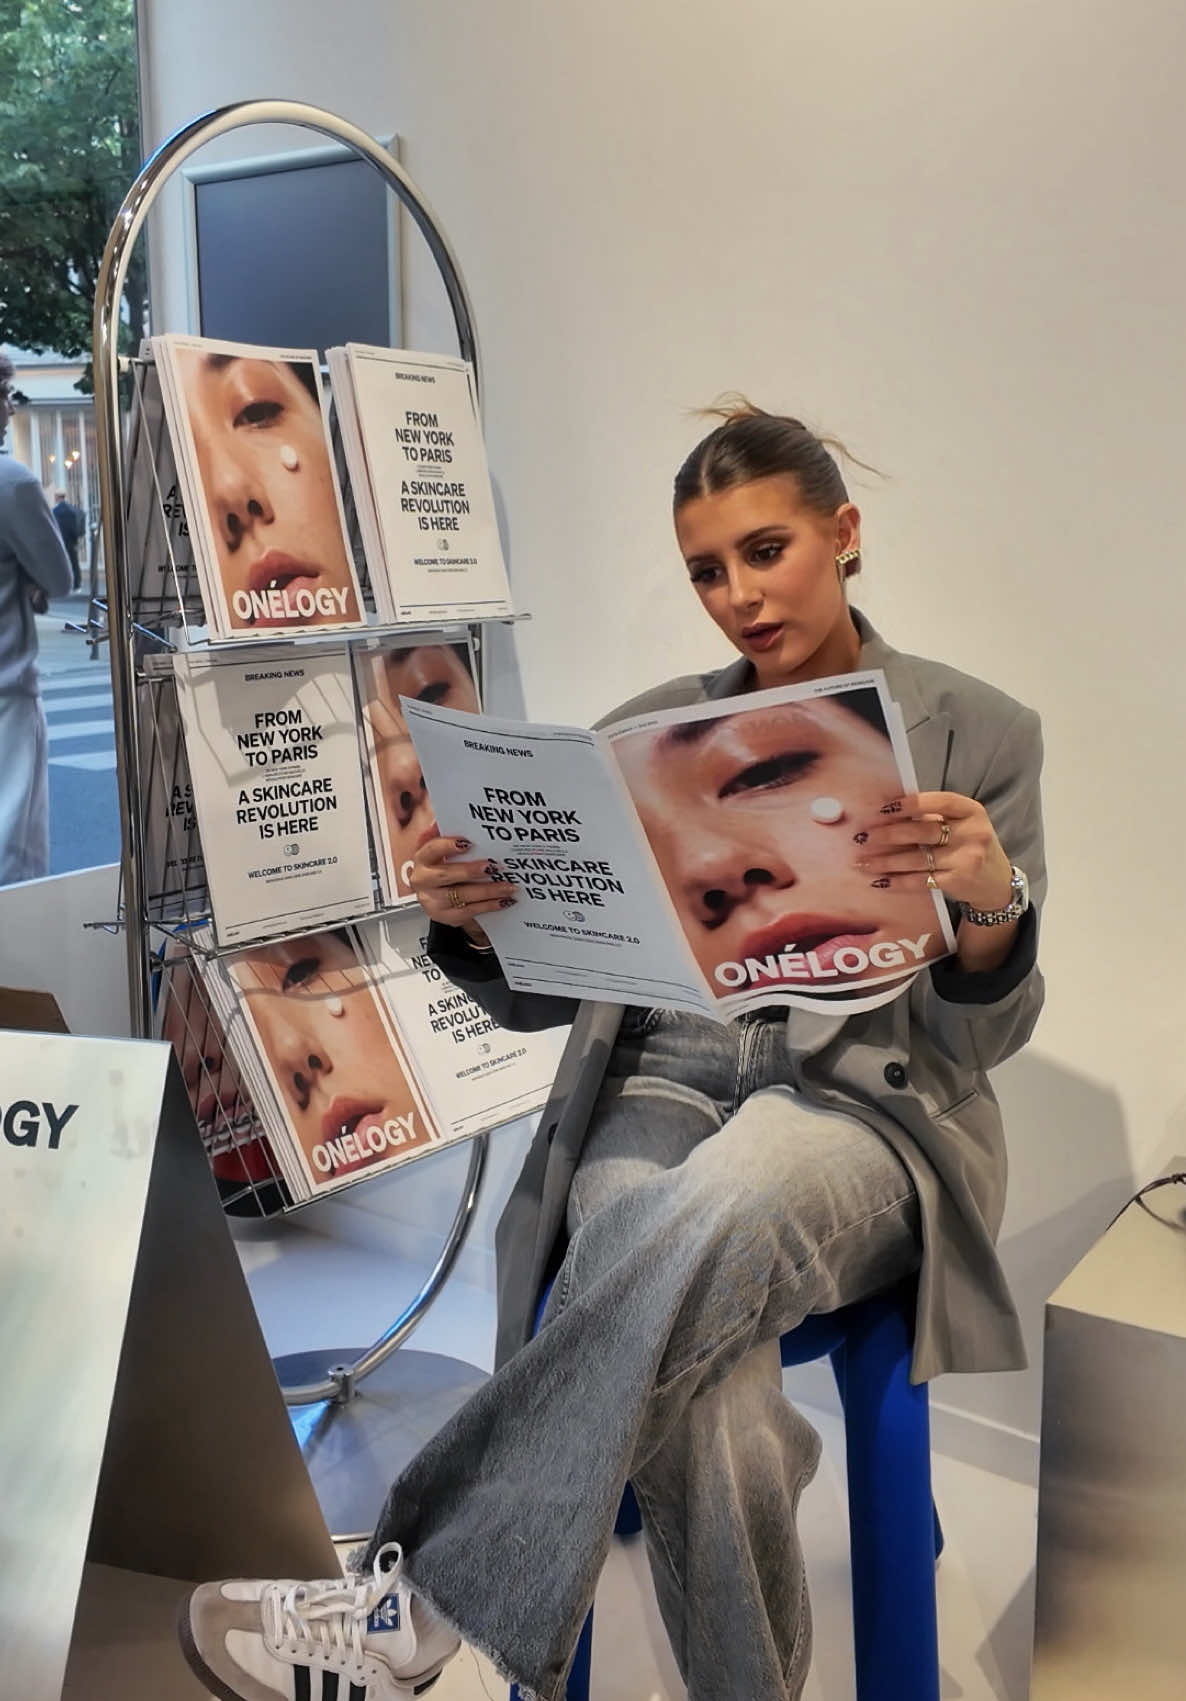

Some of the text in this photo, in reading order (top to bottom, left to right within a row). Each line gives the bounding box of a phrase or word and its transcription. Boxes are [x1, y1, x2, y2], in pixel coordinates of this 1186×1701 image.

[405, 410, 439, 428] FROM
[395, 428, 455, 447] NEW YORK
[402, 446, 453, 463] TO PARIS
[401, 480, 466, 497] A SKINCARE
[400, 498, 470, 514] REVOLUTION
[418, 516, 460, 531] IS HERE
[232, 580, 348, 620] ONÉLOGY
[244, 669, 304, 681] BREAKING NEWS
[255, 709, 302, 728] FROM
[237, 725, 323, 750] NEW YORK
[245, 744, 318, 767] TO PARIS
[463, 740, 534, 758] BREAKING NEWS
[238, 778, 333, 805] A SKINCARE
[483, 787, 547, 807] FROM
[236, 795, 337, 824] REVOLUTION
[468, 803, 583, 825] NEW YORK
[259, 816, 319, 840] IS HERE
[481, 824, 580, 843] TO PARIS
[248, 867, 281, 879] WELCOME
[283, 865, 293, 873] TO
[293, 858, 326, 870] SKINCARE
[328, 856, 338, 865] 2.0
[503, 858, 614, 876] SKINCARE
[526, 887, 605, 907] IS HERE
[523, 921, 567, 933] WELCOME
[568, 927, 581, 935] TO
[581, 929, 626, 942] SKINCARE
[626, 936, 640, 945] 2.0
[714, 933, 932, 987] ONÉLOGY
[422, 968, 441, 983] TO
[428, 1004, 438, 1016] A
[452, 1029, 465, 1044] IS
[312, 1111, 417, 1172] ONÉLOGY
